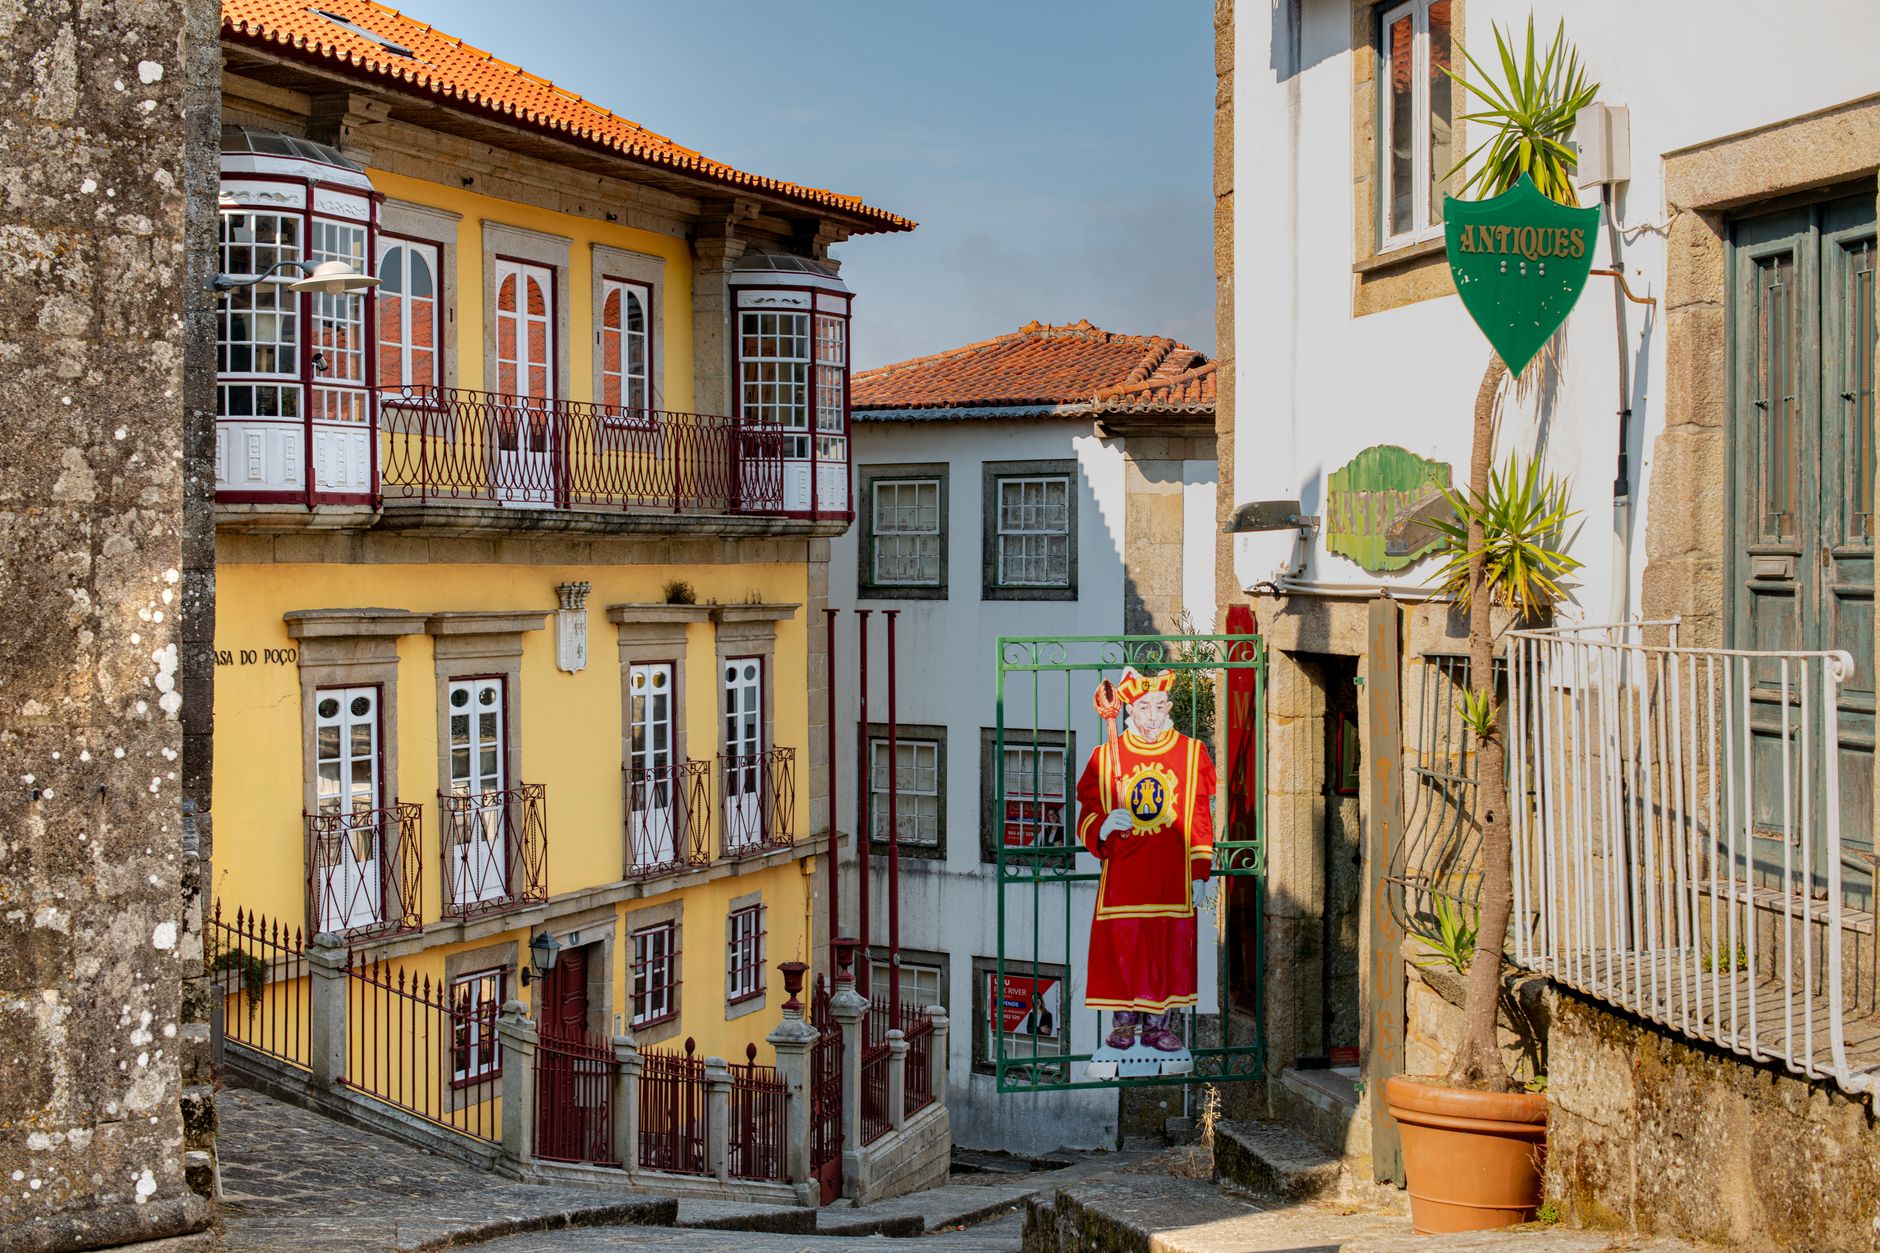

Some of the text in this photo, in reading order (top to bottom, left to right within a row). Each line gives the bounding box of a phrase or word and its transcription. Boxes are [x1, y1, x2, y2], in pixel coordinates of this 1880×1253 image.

[1459, 224, 1586, 262] ANTIQUES
[240, 649, 257, 665] DO
[264, 648, 297, 666] POÇO
